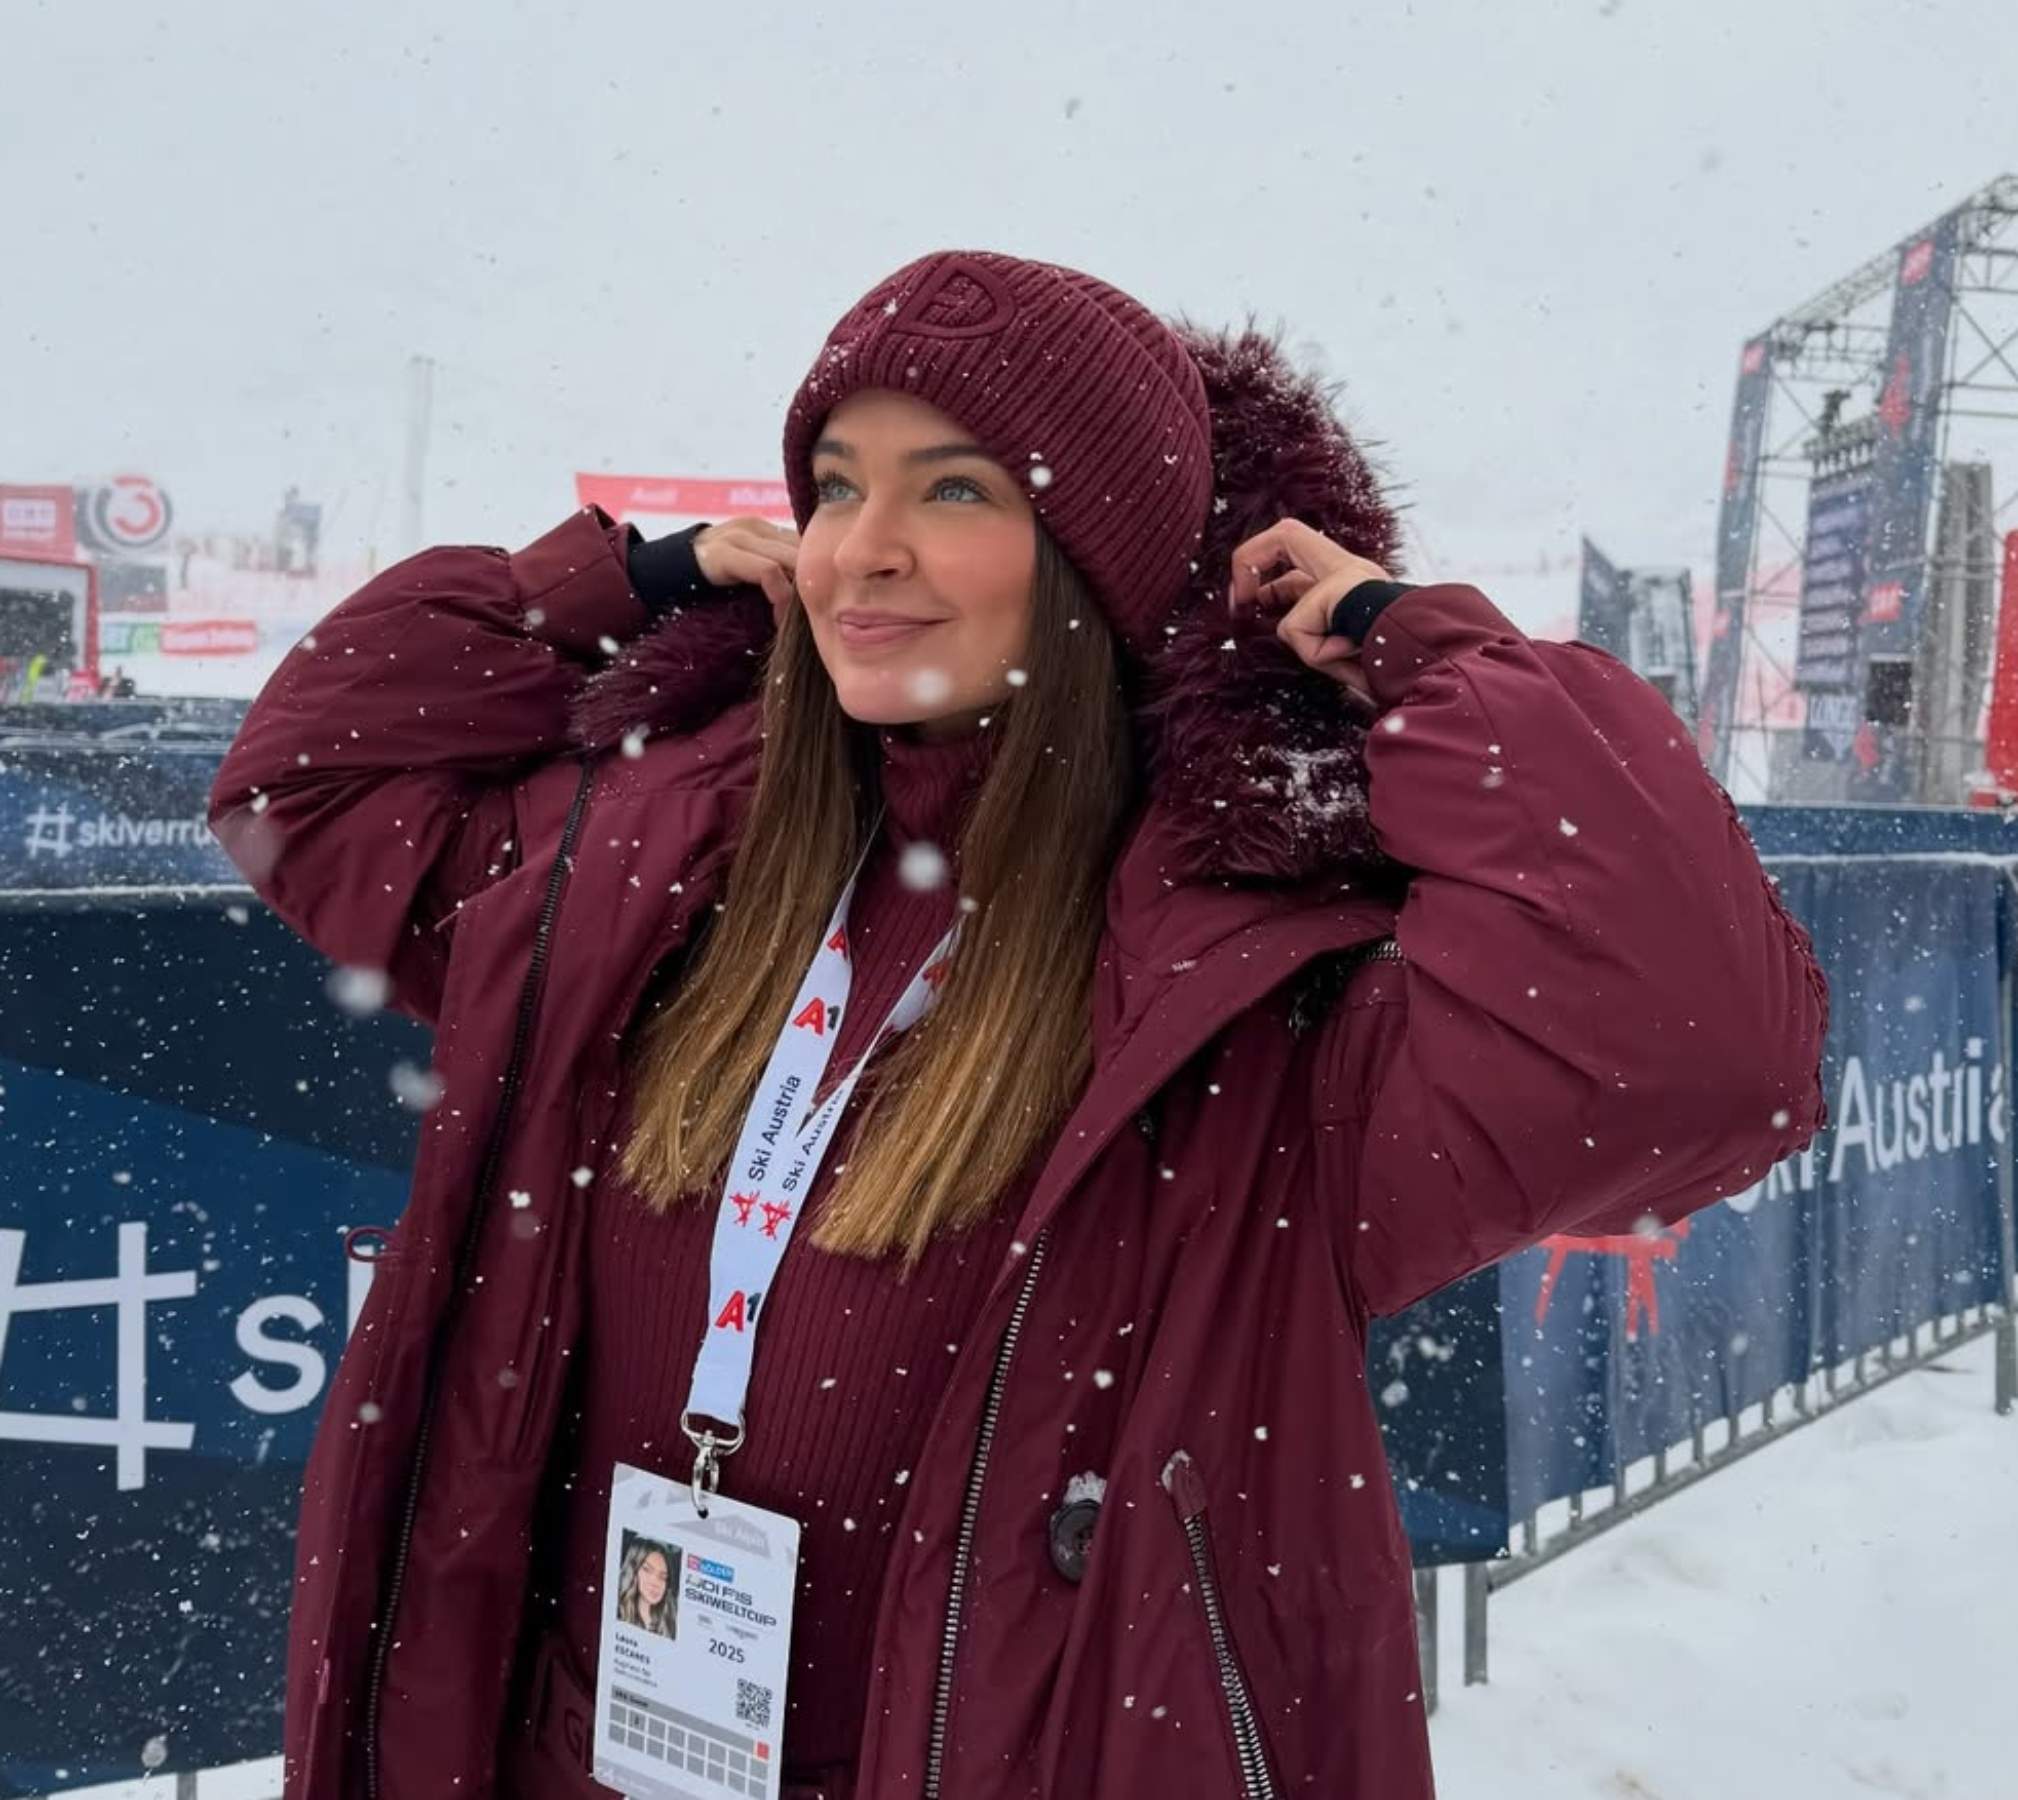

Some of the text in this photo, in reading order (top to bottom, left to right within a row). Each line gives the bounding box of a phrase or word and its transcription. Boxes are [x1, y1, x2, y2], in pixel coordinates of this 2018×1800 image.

[792, 997, 841, 1036] A1
[749, 1074, 802, 1182] Ski Austria
[781, 1160, 806, 1192] Ski
[714, 1290, 762, 1333] A1
[684, 1587, 778, 1627] SKIWELTCUP
[708, 1637, 745, 1664] 2025
